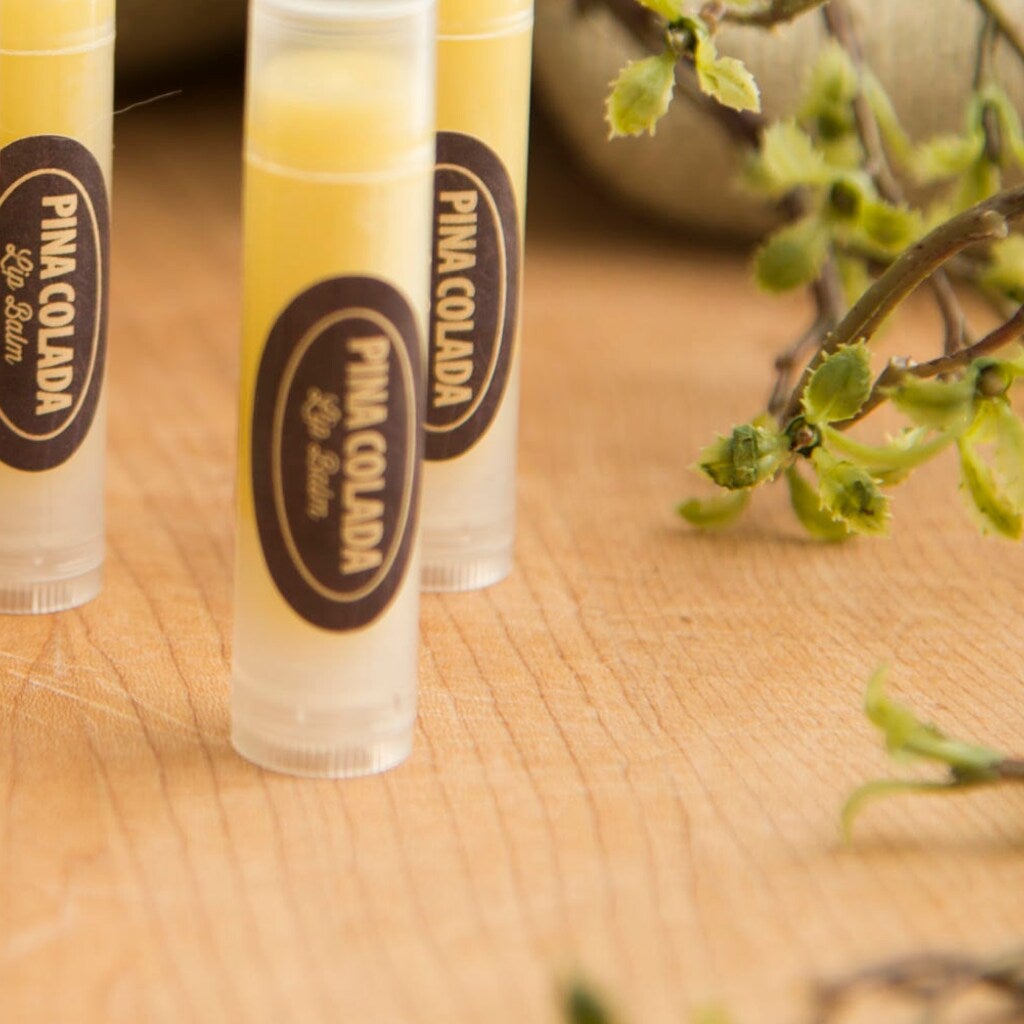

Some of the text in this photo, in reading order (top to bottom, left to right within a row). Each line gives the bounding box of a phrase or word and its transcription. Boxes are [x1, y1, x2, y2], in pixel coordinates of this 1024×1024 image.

[0, 242, 34, 365] Lip Balm
[35, 192, 78, 416] PINA COLADA
[433, 190, 478, 409] PINA COLADA
[340, 336, 391, 575] PINA COLADA
